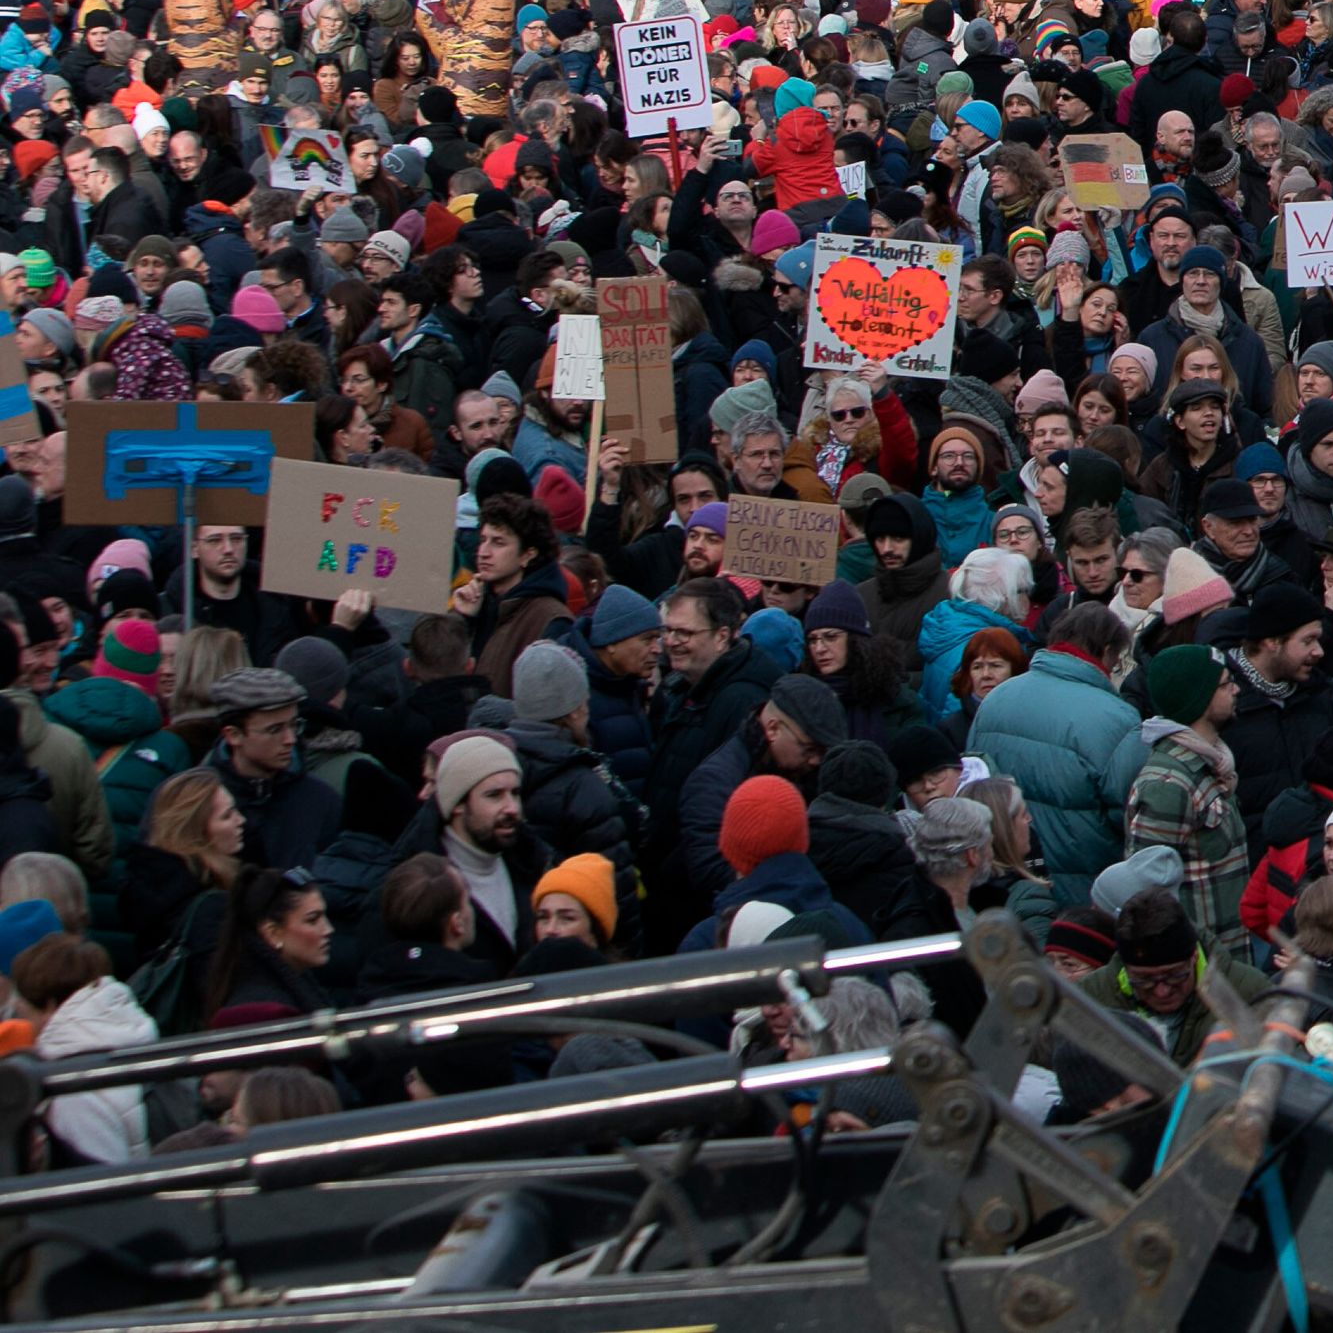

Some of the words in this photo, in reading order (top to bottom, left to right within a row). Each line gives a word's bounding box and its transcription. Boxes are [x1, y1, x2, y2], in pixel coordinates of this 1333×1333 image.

[638, 25, 677, 43] KEIN
[630, 44, 691, 67] DÖNER
[646, 68, 680, 85] FÜR
[640, 88, 692, 108] NAZIS
[603, 284, 670, 324] SOLI
[832, 279, 929, 318] Vielfältig
[837, 311, 922, 340] tolerant
[812, 341, 857, 366] Kinder
[320, 492, 401, 535] FCK
[728, 498, 785, 529] BRAUNE
[316, 539, 398, 579] AFD
